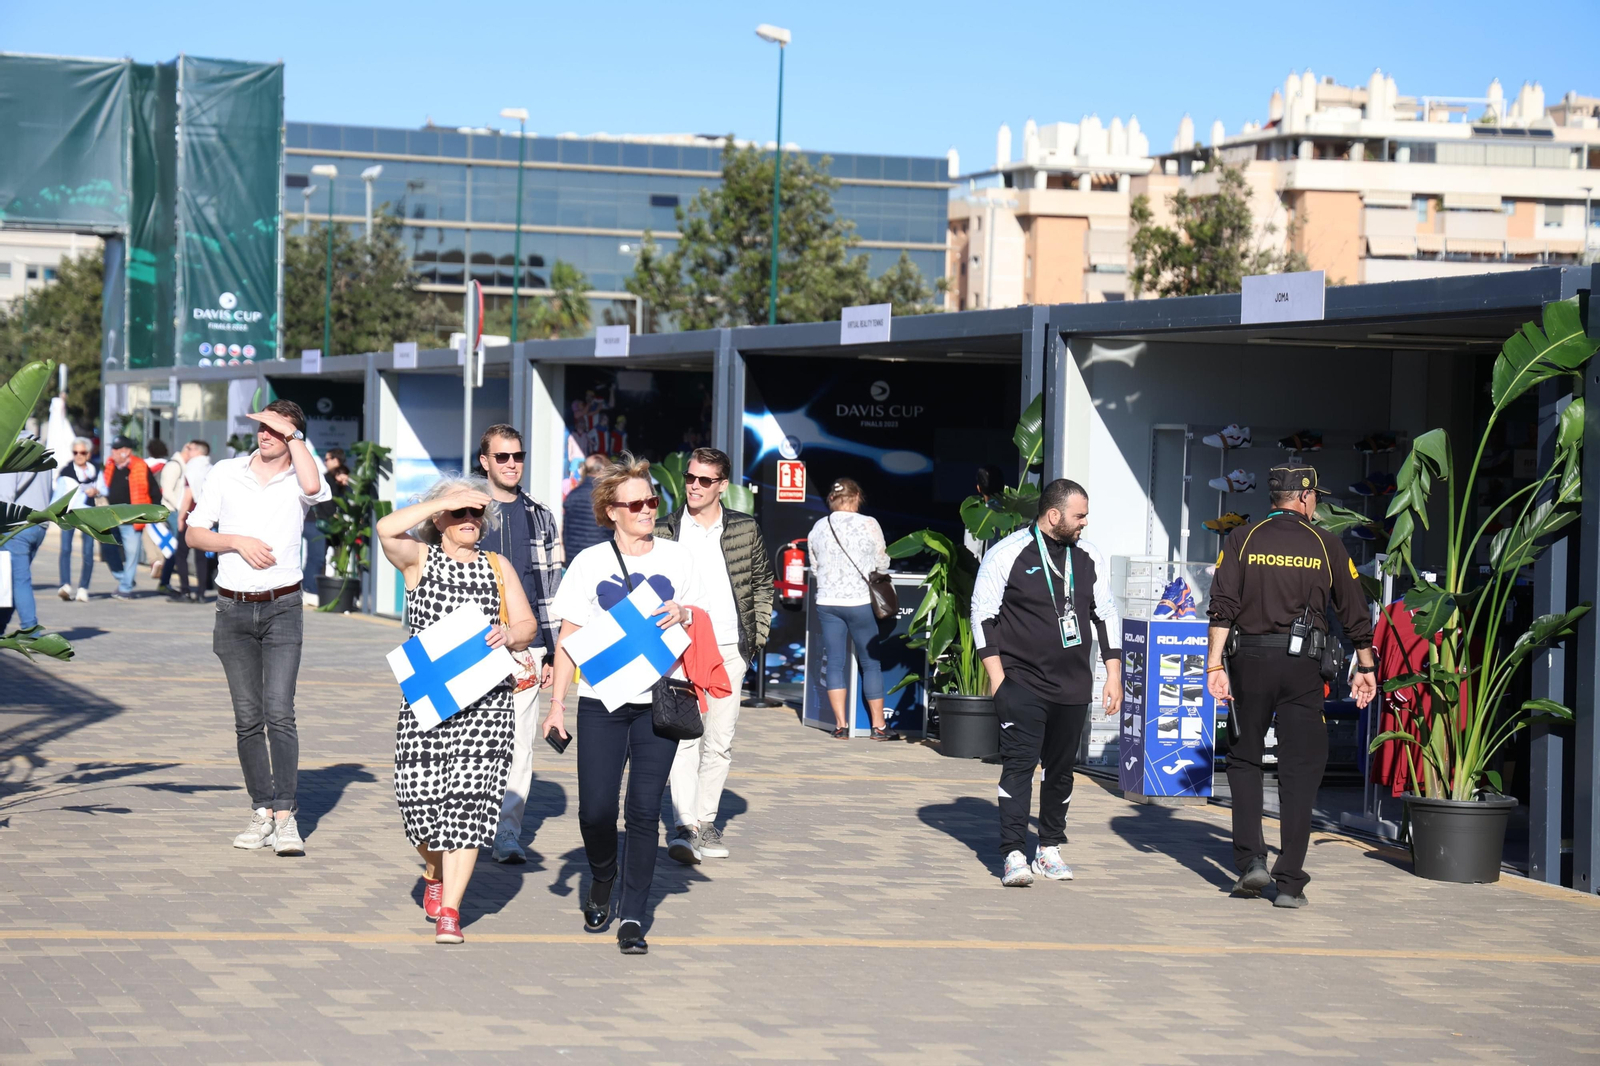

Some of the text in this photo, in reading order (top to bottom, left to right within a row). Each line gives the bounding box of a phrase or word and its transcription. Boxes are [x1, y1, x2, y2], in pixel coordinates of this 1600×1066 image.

[1275, 292, 1289, 302] JOMA
[193, 308, 262, 322] DAVIS CUP
[836, 404, 924, 417] DAVIS CUP
[860, 420, 883, 428] FINALS
[1248, 554, 1321, 570] PROSEGUR
[1125, 633, 1145, 644] ROLAND
[1157, 635, 1208, 646] ROLAND
[883, 710, 893, 719] TF
[1217, 721, 1227, 729] JO
